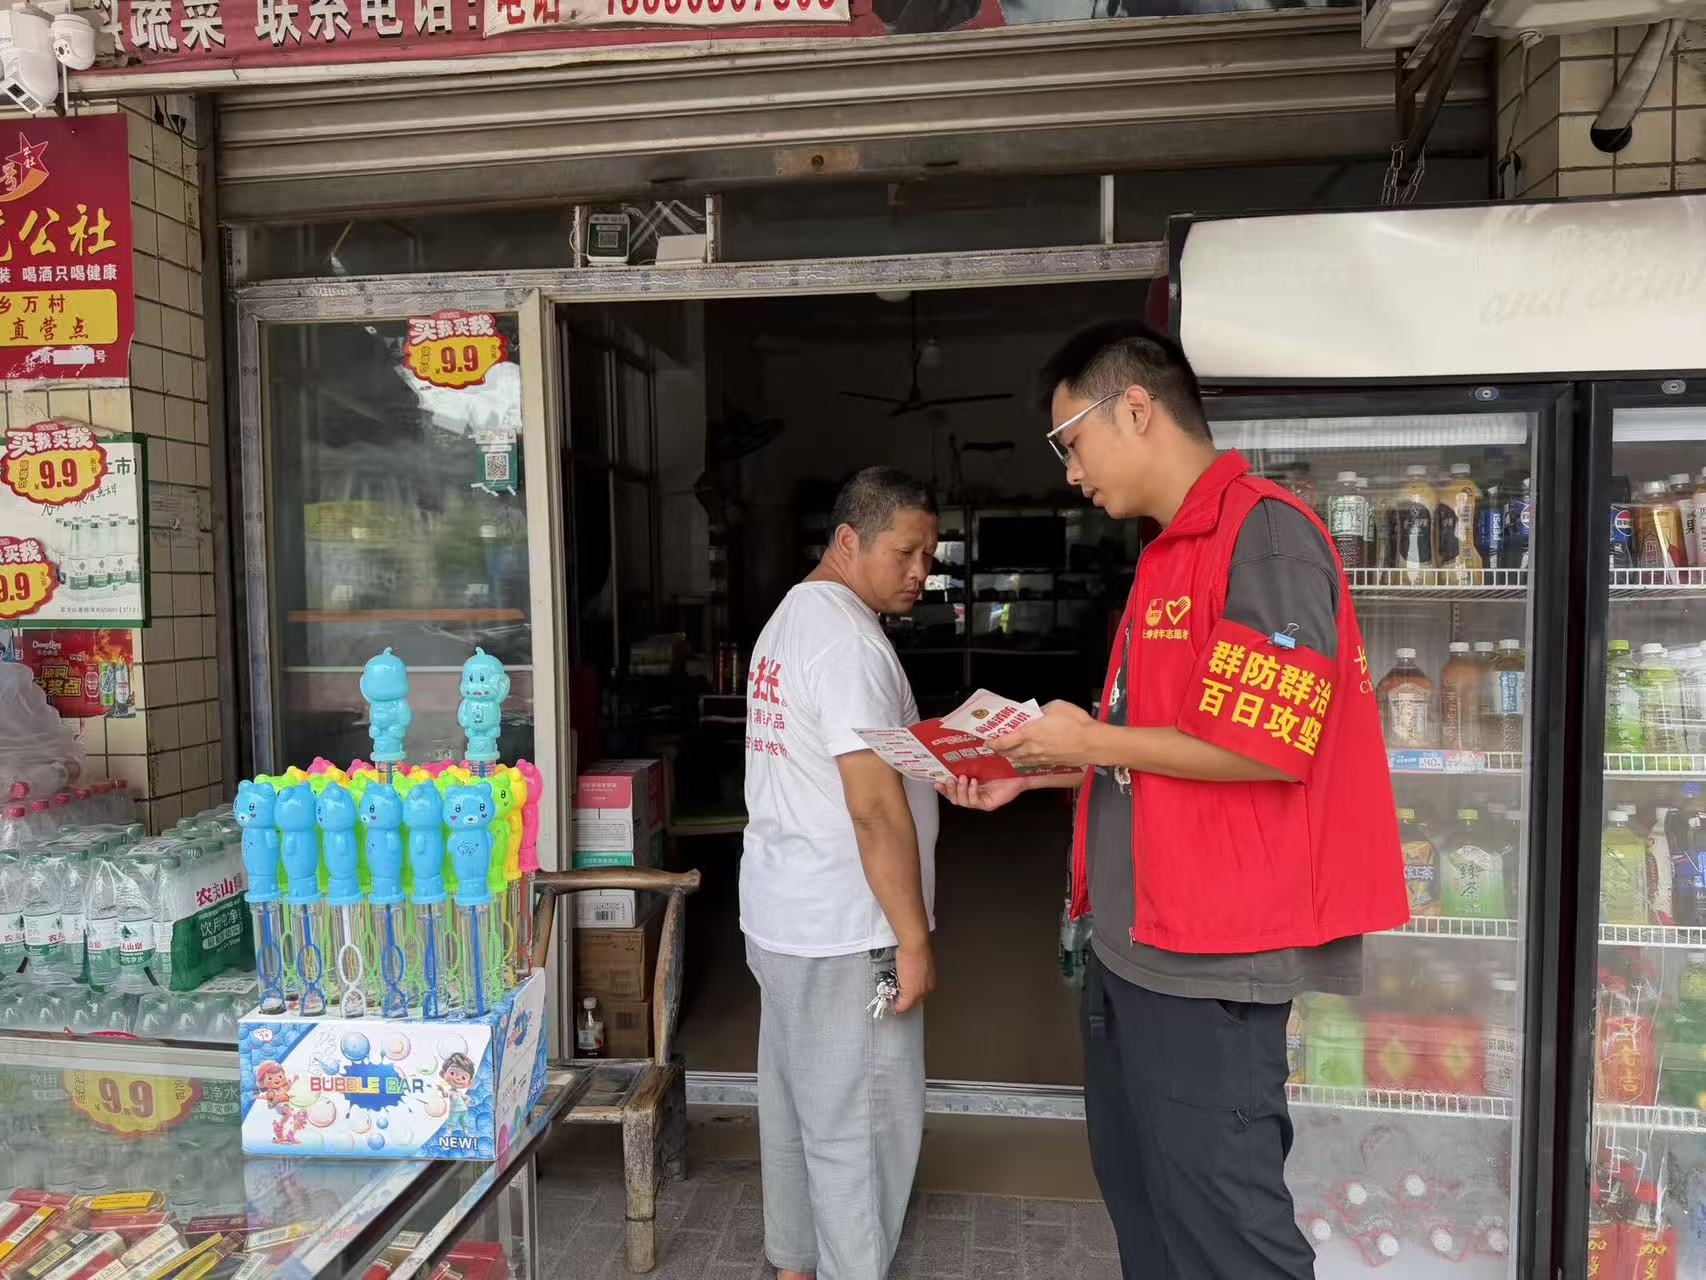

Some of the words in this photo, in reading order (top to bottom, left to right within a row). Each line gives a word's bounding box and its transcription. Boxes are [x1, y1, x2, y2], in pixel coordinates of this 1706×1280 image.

[22, 263, 118, 283] 喝酒只喝健康
[9, 316, 89, 342] 直营点
[6, 427, 94, 458] 买我买我
[1208, 640, 1332, 718] 群防群治
[1198, 677, 1323, 757] 百日攻坚
[310, 1076, 379, 1094] BUBBLE
[386, 1076, 424, 1094] BAR
[438, 1136, 478, 1151] NEW!
